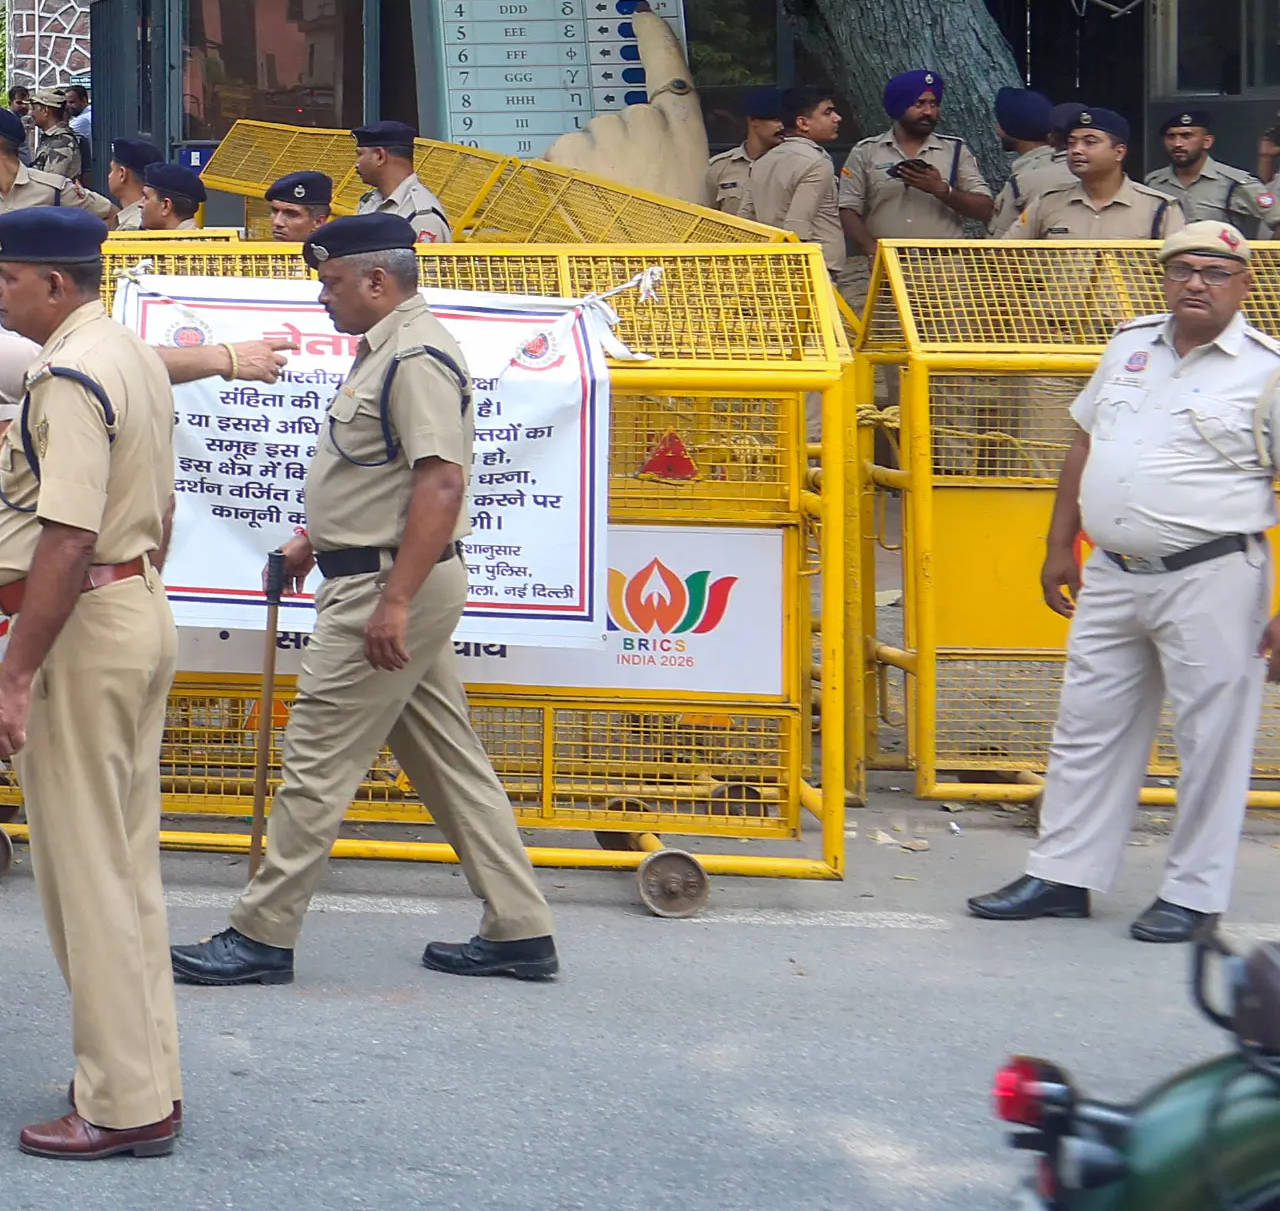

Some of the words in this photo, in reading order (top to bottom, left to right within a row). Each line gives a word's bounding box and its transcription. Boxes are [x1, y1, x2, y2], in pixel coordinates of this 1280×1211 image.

[454, 4, 465, 17] 4
[499, 5, 528, 15] DDD
[457, 26, 466, 40] 5
[504, 27, 527, 37] EEE
[458, 49, 468, 63] 6
[506, 50, 528, 59] FFF
[459, 71, 469, 85] 7
[504, 73, 533, 82] GGG
[461, 94, 472, 108] 8
[506, 96, 535, 105] HHH
[463, 117, 473, 131] 9
[515, 119, 529, 128] III
[516, 140, 532, 153] JJJ
[219, 387, 285, 408] संहिता
[291, 390, 321, 410] की
[186, 413, 211, 428] या
[217, 414, 269, 433] इससे
[275, 415, 324, 436] अधि
[525, 425, 554, 439] का
[206, 437, 256, 461] समूह
[264, 442, 300, 459] इस
[482, 447, 512, 466] हो,
[178, 456, 213, 473] इस
[218, 458, 253, 477] क्षेत्र
[259, 460, 282, 478] में
[478, 470, 537, 485] धरना,
[229, 481, 289, 502] वर्जित
[473, 489, 527, 507] करने
[532, 494, 564, 509] पर
[211, 504, 281, 528] कानूनी
[485, 561, 533, 581] पुलिस,
[503, 584, 527, 599] नई
[532, 583, 574, 600] दिल्ली
[623, 637, 688, 653] BRICS
[616, 654, 656, 667] INDIA
[660, 655, 695, 668] 2026
